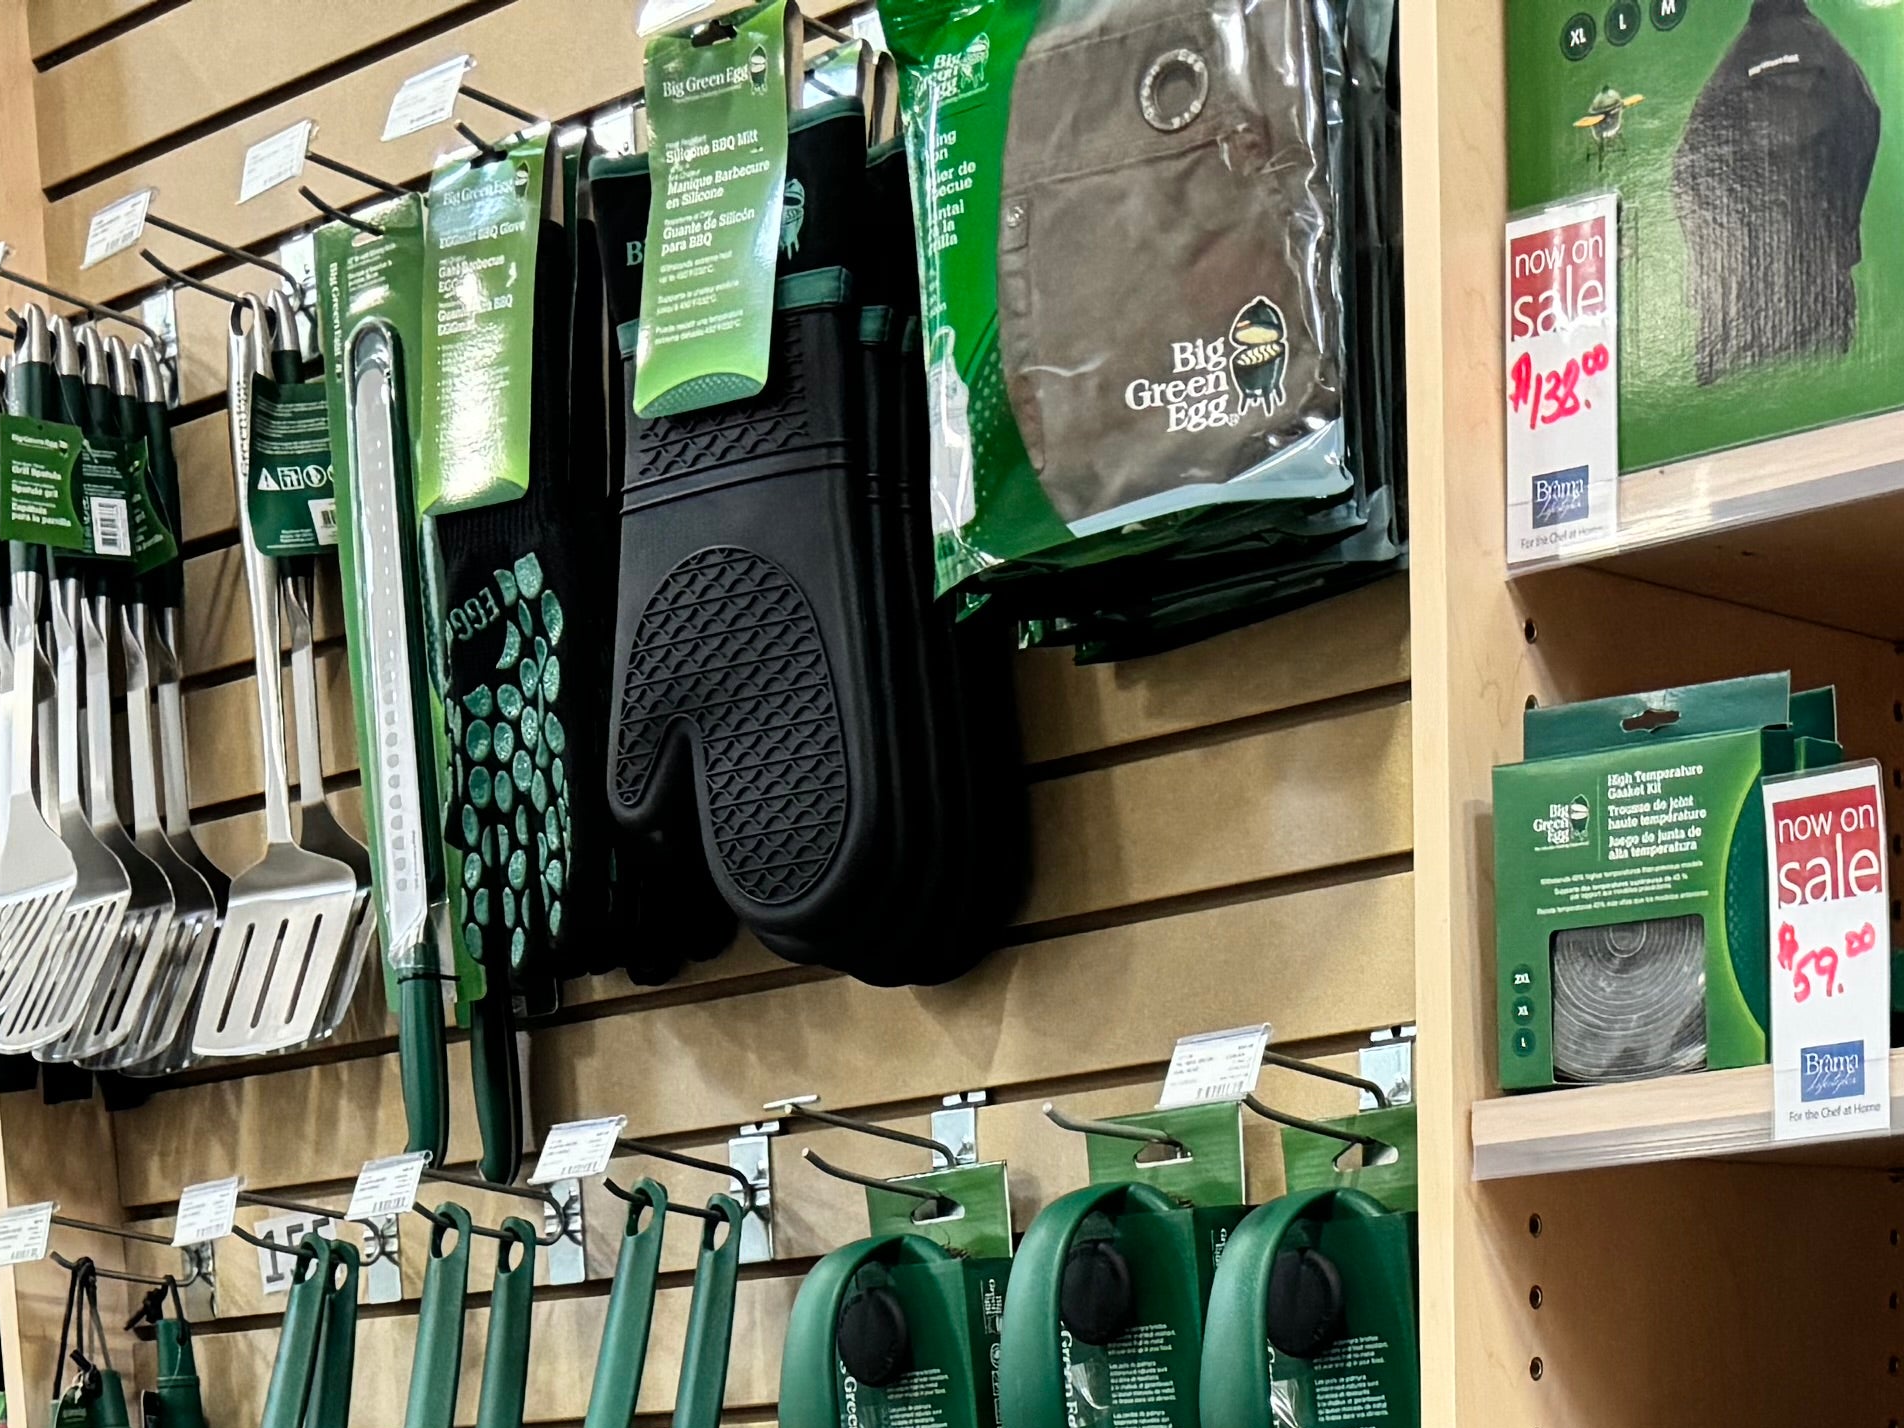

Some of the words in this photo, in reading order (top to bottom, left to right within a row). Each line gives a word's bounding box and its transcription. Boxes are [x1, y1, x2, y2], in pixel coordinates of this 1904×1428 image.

[1569, 27, 1587, 46] XL
[1618, 14, 1627, 30] L
[663, 79, 684, 99] Big
[686, 70, 725, 95] Green
[726, 63, 748, 85] Egg
[712, 135, 735, 153] BBQ
[663, 223, 702, 240] Guante
[689, 233, 713, 249] BBQ
[1515, 239, 1565, 279] now
[1572, 233, 1603, 264] on
[1514, 264, 1606, 340] sale
[1170, 338, 1228, 374] Big
[1124, 372, 1230, 412] Green
[1166, 401, 1229, 433] Egg
[1535, 478, 1586, 502] Brama
[1778, 813, 1832, 842] now
[1841, 804, 1874, 830] on
[1779, 833, 1881, 908] sale
[1805, 1051, 1859, 1078] Brama
